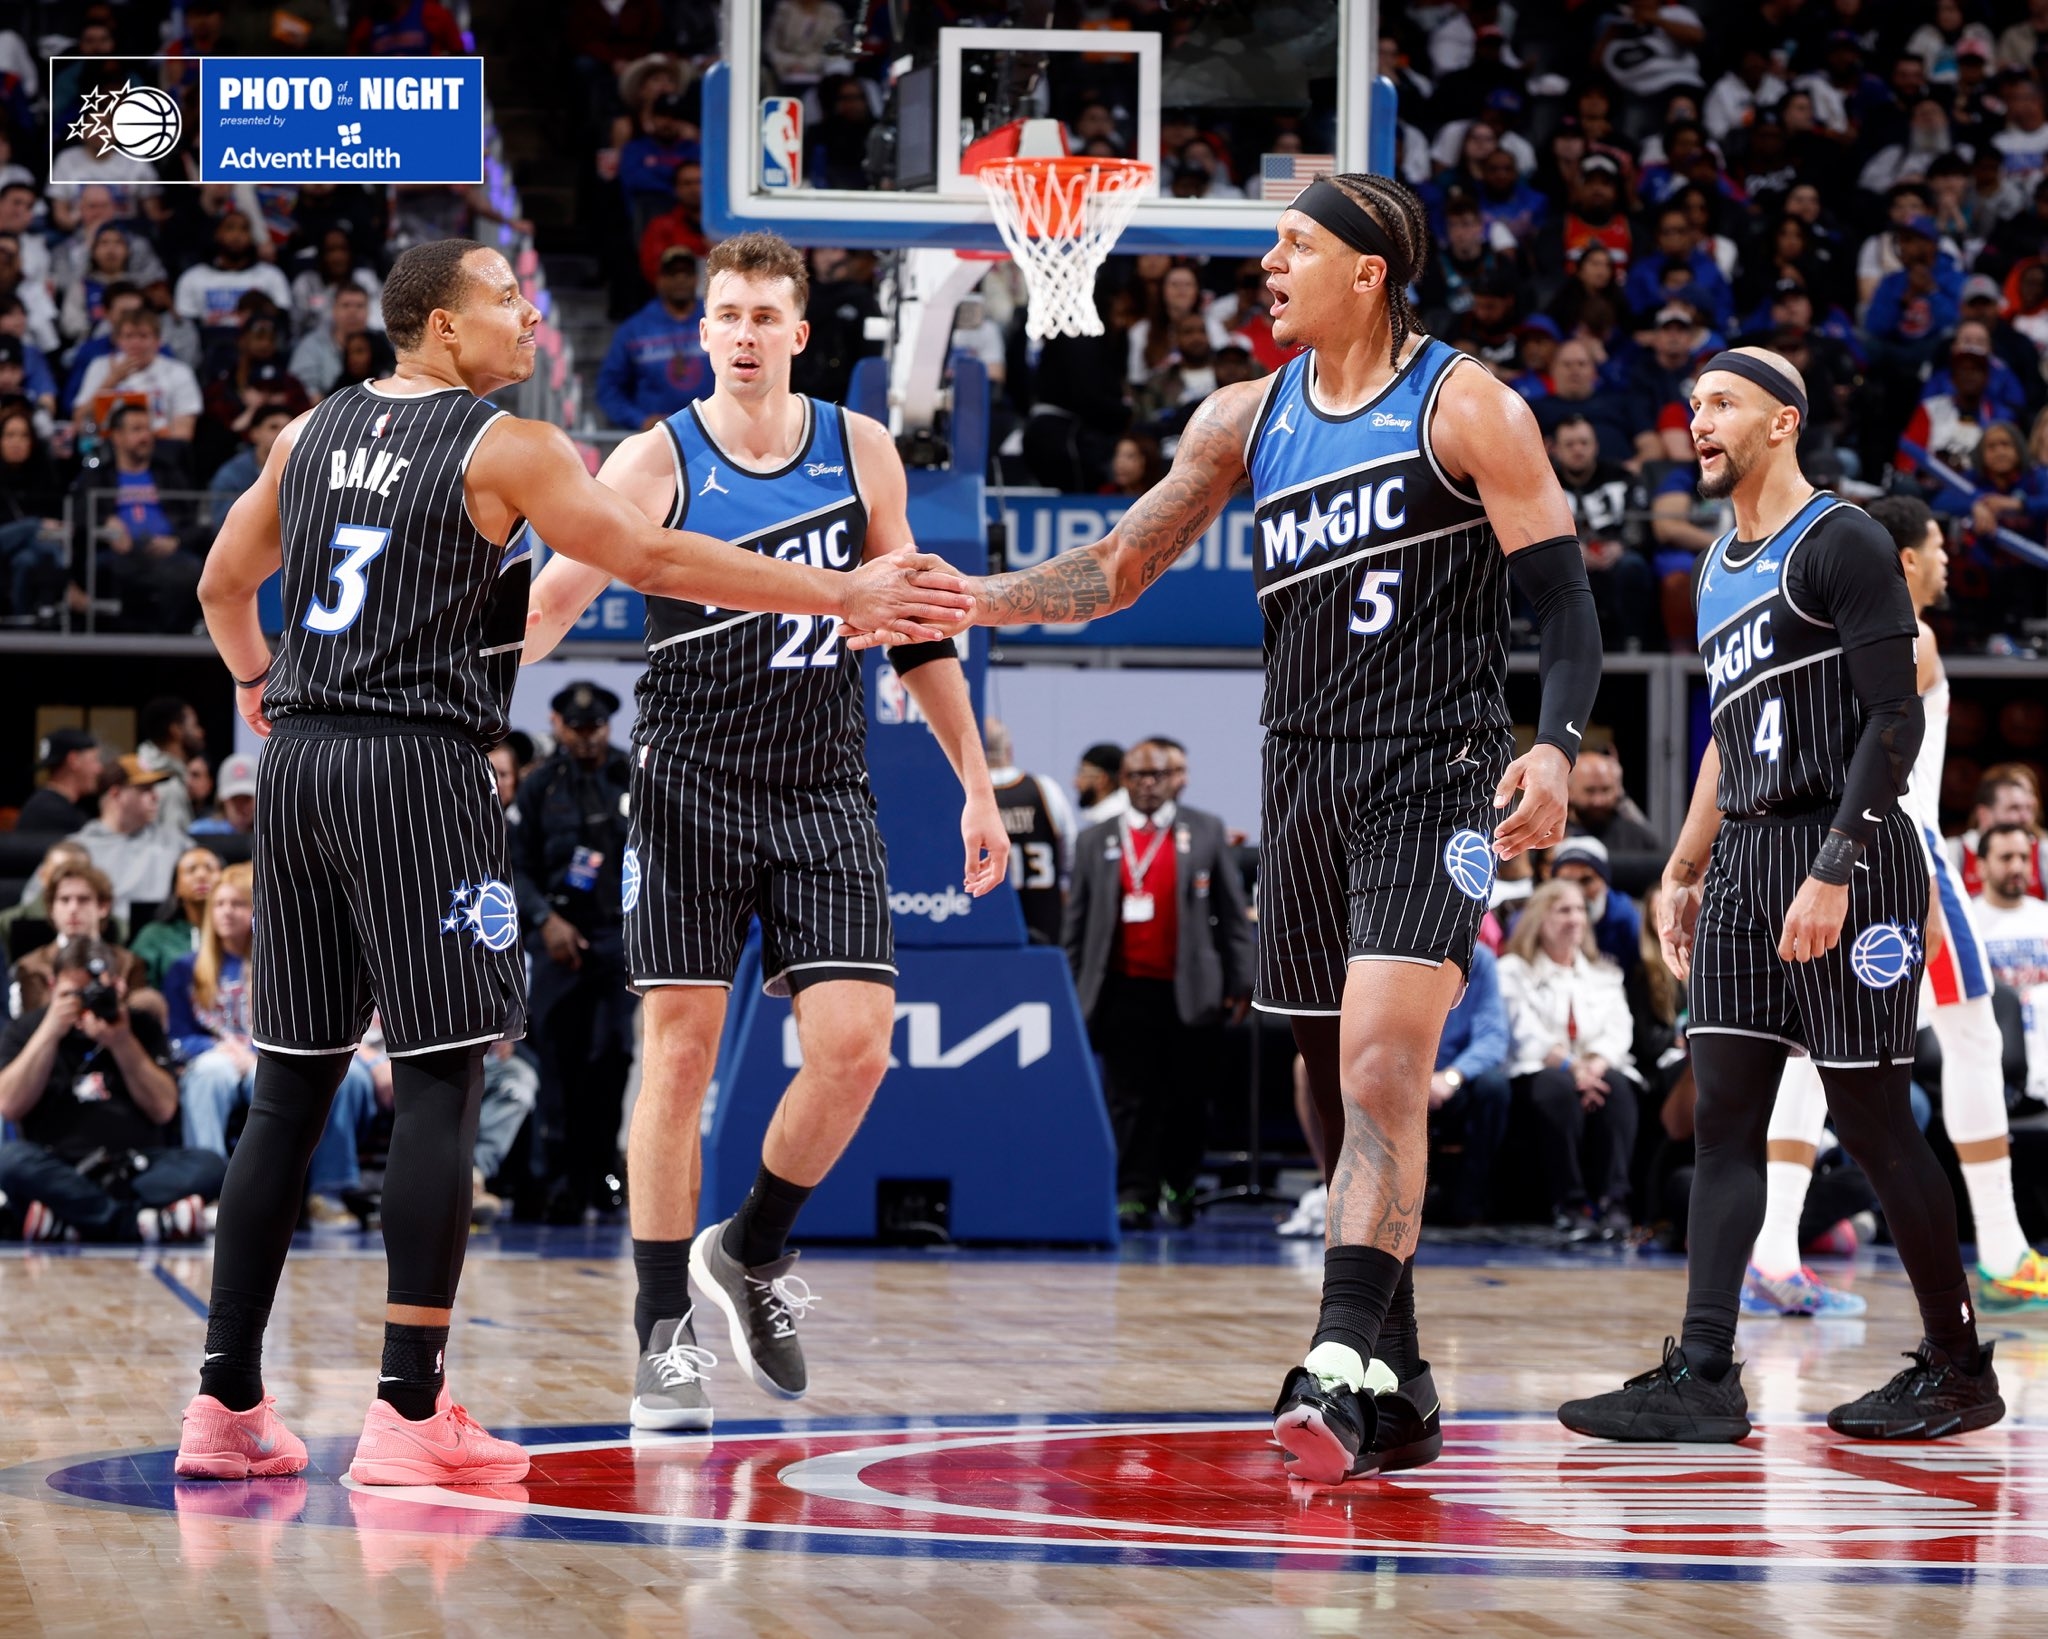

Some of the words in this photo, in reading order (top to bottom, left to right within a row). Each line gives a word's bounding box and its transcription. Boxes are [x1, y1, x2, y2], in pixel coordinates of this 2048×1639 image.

[1371, 411, 1412, 431] Disney
[330, 447, 410, 498] BANE
[804, 462, 845, 477] Disney
[300, 522, 393, 636] 3
[1347, 568, 1404, 636] 5
[767, 612, 843, 670] 22
[1752, 696, 1784, 764] 4
[888, 885, 971, 922] oogle
[783, 1001, 1051, 1069] IA
